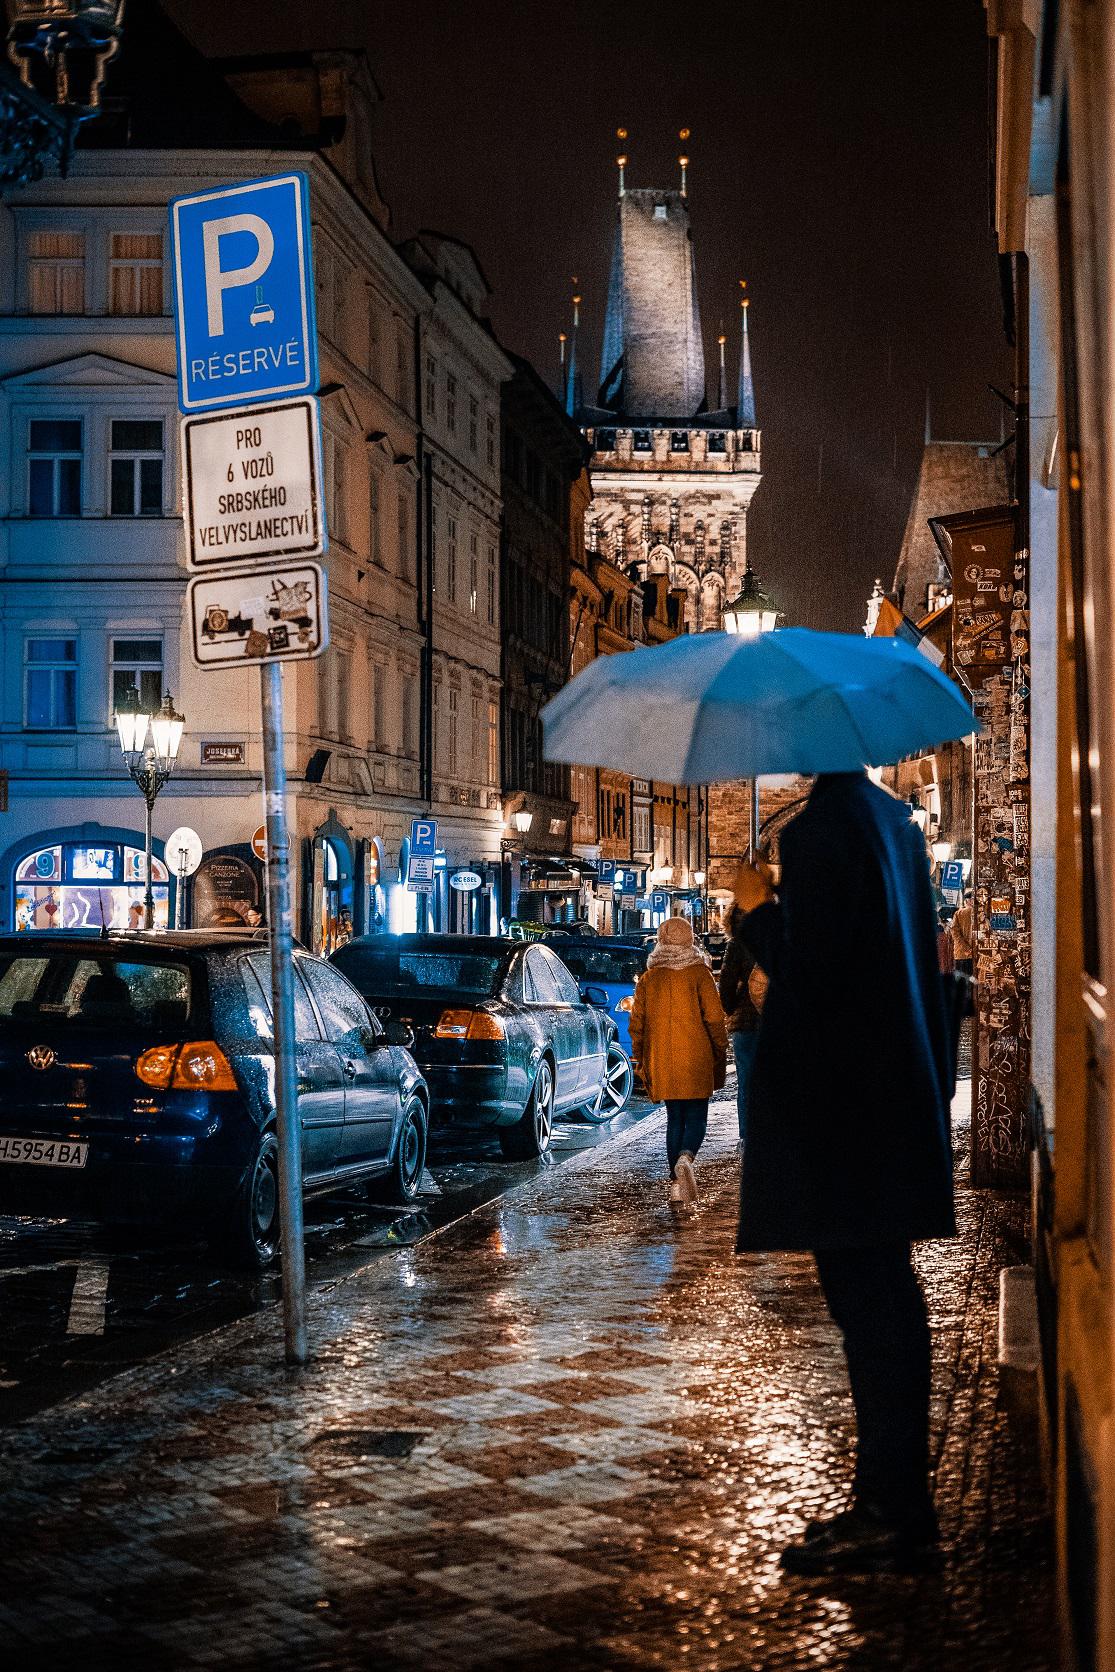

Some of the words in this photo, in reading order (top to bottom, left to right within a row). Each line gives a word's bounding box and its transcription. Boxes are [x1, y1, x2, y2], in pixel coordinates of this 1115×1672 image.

[202, 213, 275, 337] P
[191, 337, 300, 383] RÉSERVÉ
[236, 427, 262, 450] PRO
[227, 463, 234, 483] 6
[242, 451, 274, 480] VOZŮ
[218, 484, 287, 515] SRBSKÉHO
[200, 509, 309, 548] VELVYSLANECTVÍ
[416, 824, 431, 845] P
[602, 862, 612, 875] P
[946, 864, 959, 880] P
[625, 874, 634, 887] P
[654, 895, 663, 907] P
